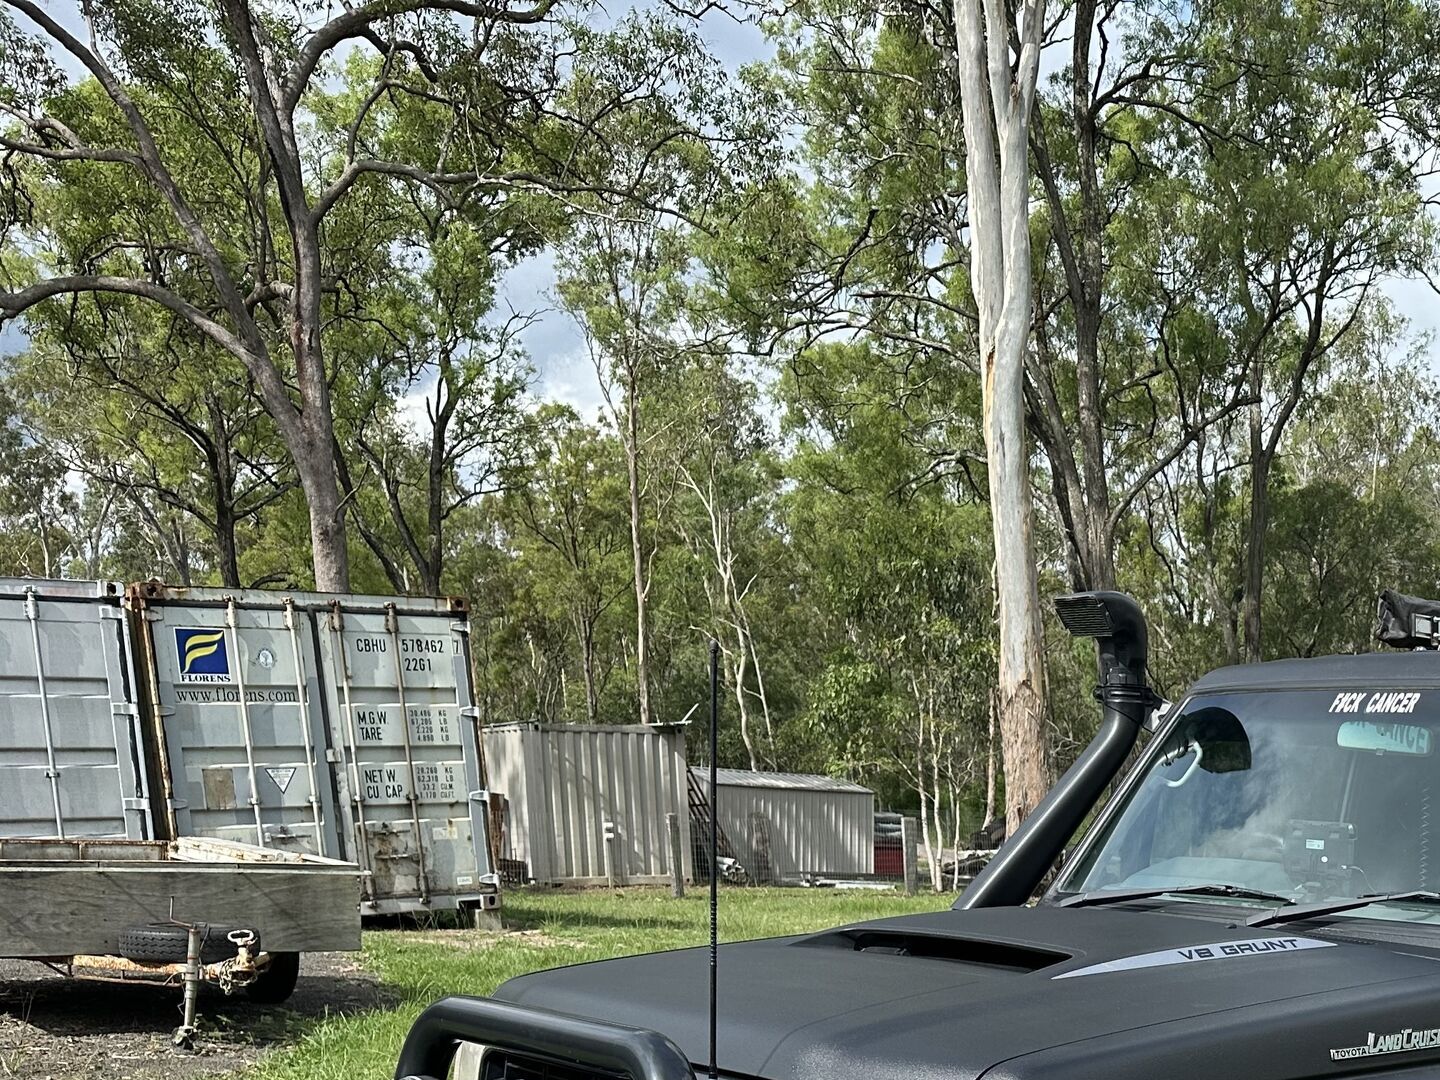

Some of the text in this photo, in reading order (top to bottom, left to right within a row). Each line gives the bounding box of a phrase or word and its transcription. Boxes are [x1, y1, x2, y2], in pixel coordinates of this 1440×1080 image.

[356, 639, 459, 654] CBHU 578462 7
[405, 658, 432, 672] 22G1
[181, 674, 231, 683] FLORENS
[1365, 692, 1421, 713] CANCER
[360, 727, 382, 741] TARE
[365, 769, 383, 783] NET
[1178, 939, 1298, 960] V8 GRUNT
[1335, 1047, 1367, 1058] TOYOTA
